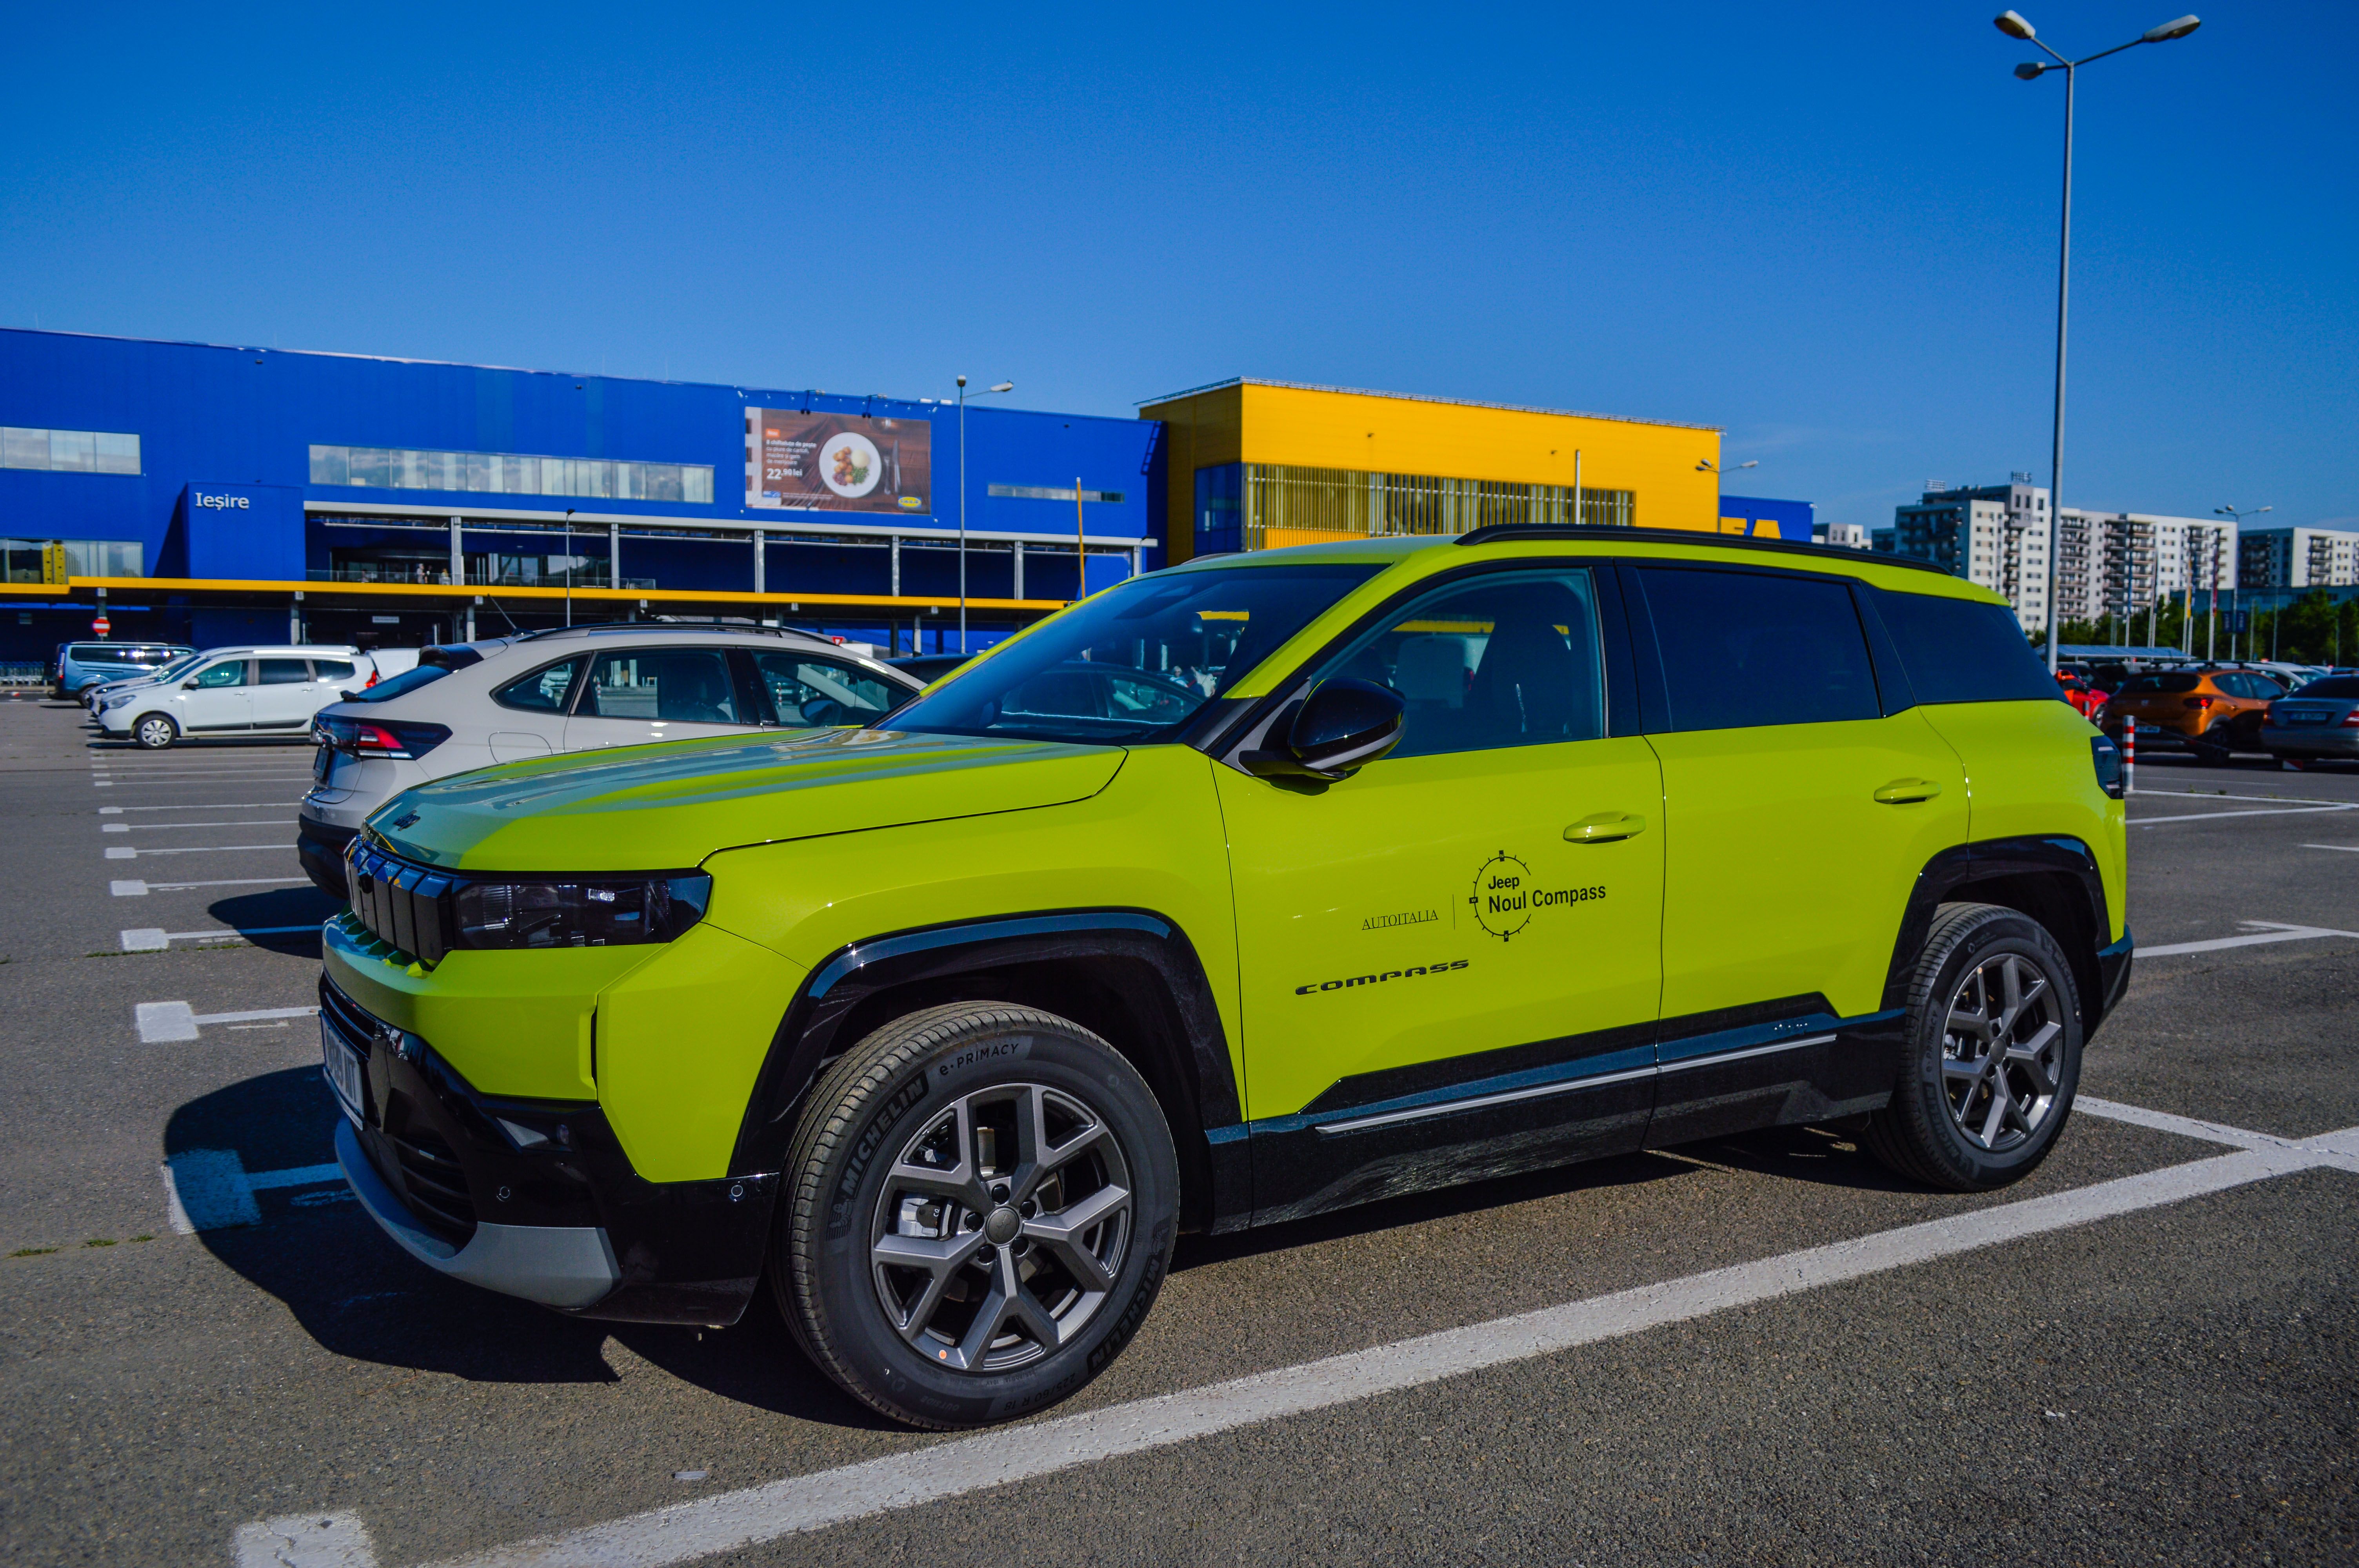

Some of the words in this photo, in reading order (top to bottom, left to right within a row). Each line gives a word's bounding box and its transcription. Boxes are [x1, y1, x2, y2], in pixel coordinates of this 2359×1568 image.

[793, 469, 803, 477] lei
[195, 492, 249, 511] Ieșire
[1488, 876, 1519, 890] Jeep
[1489, 891, 1527, 913] Noul
[1532, 886, 1606, 907] Compass
[1362, 909, 1439, 930] AUTOITALIA
[1295, 959, 1469, 995] COMPASS
[841, 1077, 925, 1196] MICHELIN
[1092, 1258, 1160, 1367] MICHELIN
[920, 1396, 960, 1410] OUTSIDE
[1005, 1402, 1016, 1411] 18
[1022, 1398, 1030, 1406] R
